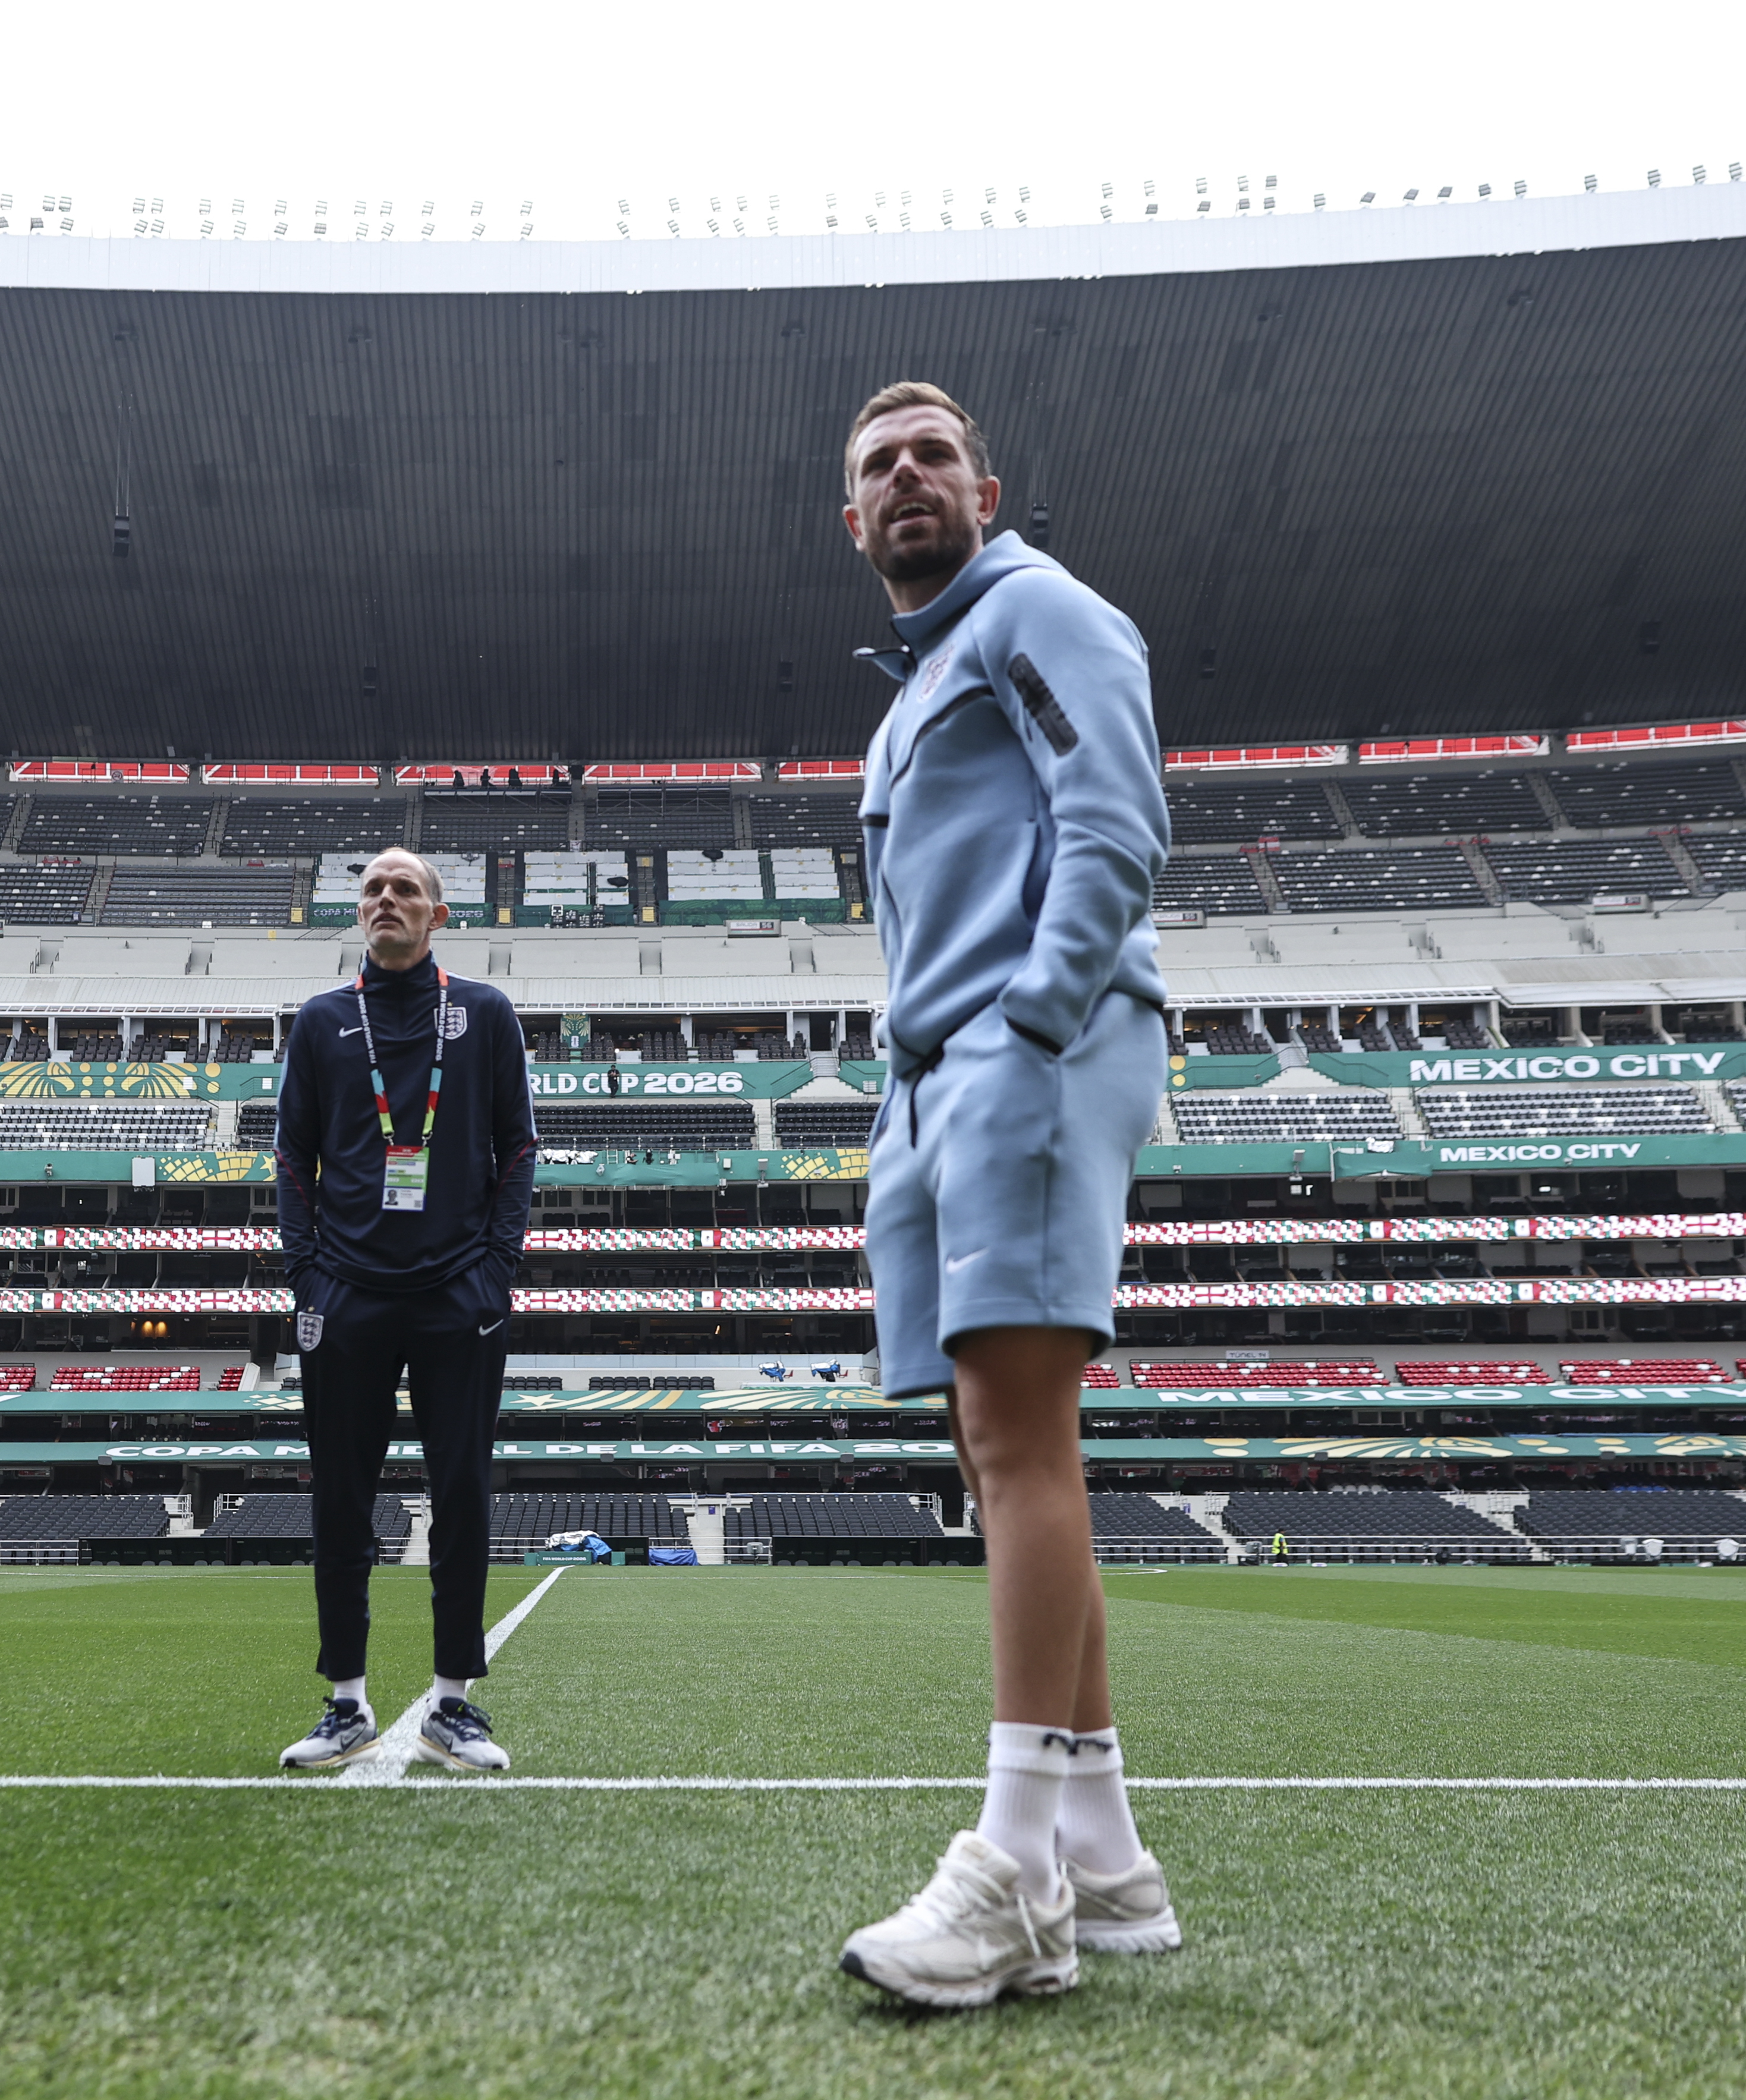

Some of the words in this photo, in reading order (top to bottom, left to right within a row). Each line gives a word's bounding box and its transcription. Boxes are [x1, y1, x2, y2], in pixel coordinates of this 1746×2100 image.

[313, 908, 341, 917] COPA
[357, 993, 367, 1014] 2026
[435, 1038, 443, 1062] 2026
[1410, 1055, 1600, 1081] MEXICO
[1609, 1052, 1726, 1077] CITY
[529, 1073, 578, 1094] RLD
[643, 1072, 743, 1093] 2026
[1440, 1145, 1562, 1162] MEXICO
[1567, 1143, 1641, 1160] CITY
[1157, 1390, 1523, 1402] MEXICO
[105, 1446, 260, 1457] COPA
[546, 1444, 618, 1454] DE
[631, 1444, 704, 1454] LA
[715, 1443, 840, 1453] FIFA
[853, 1443, 955, 1453] 20
